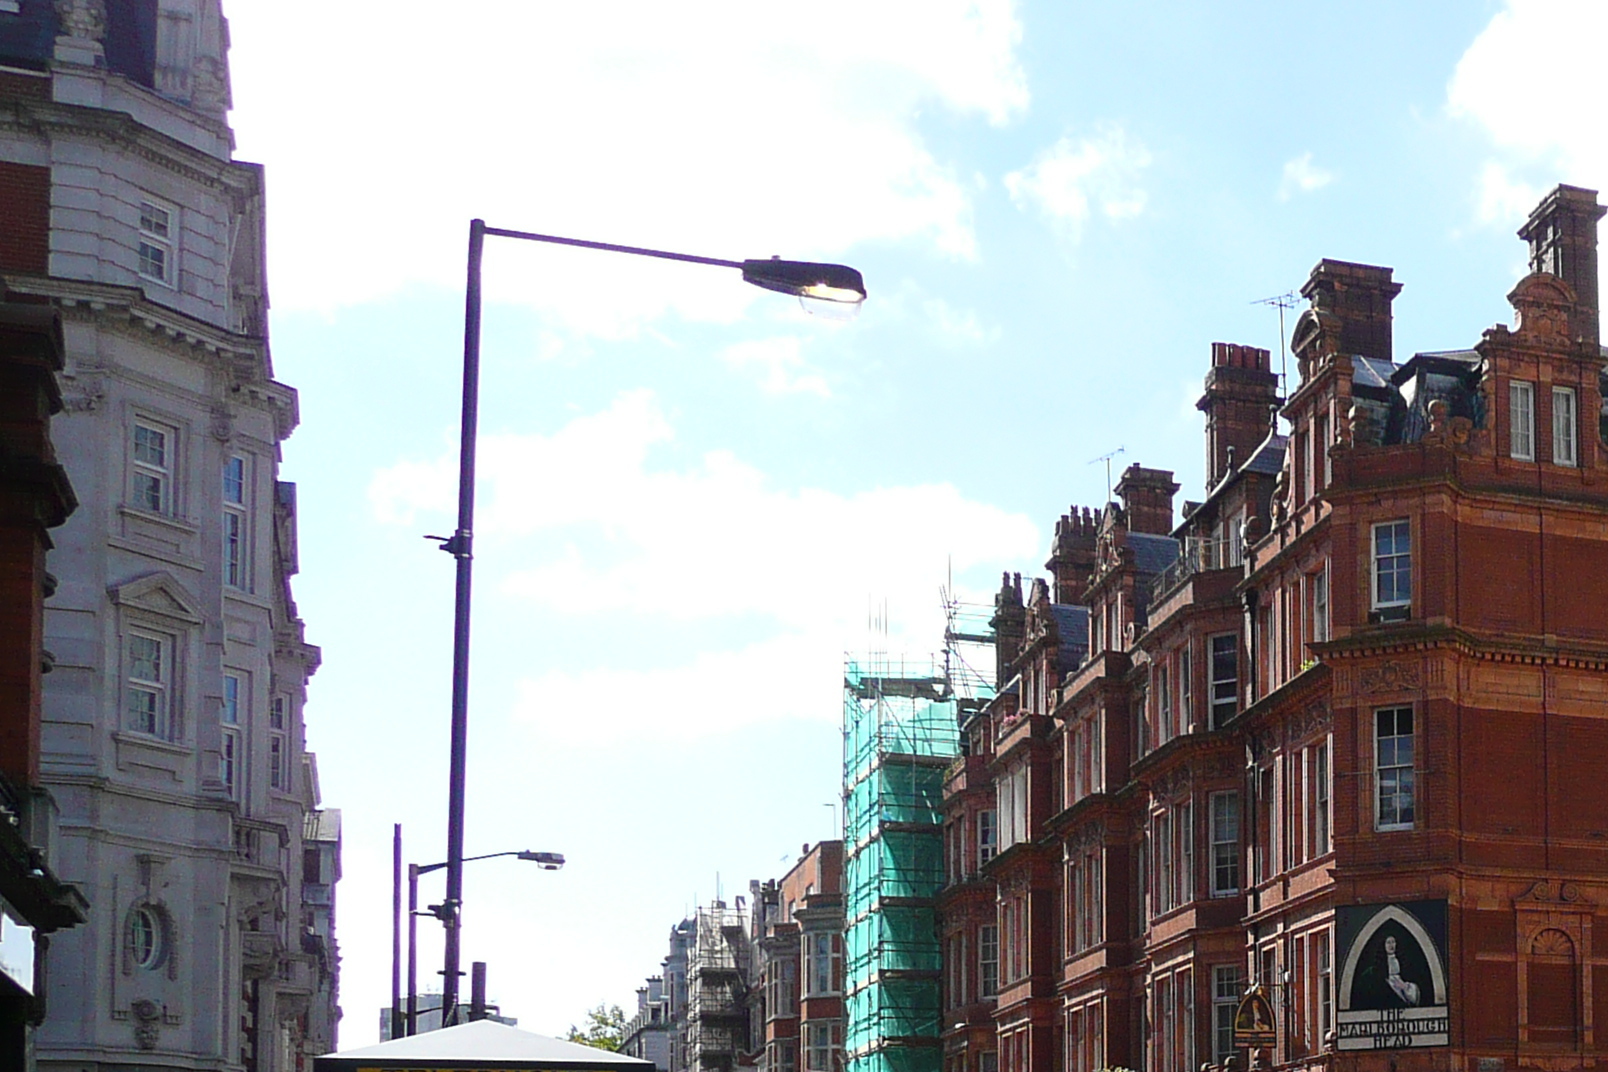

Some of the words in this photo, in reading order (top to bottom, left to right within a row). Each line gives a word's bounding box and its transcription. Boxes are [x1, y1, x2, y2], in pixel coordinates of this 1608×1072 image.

[1377, 1008, 1405, 1020] THE
[1339, 1020, 1447, 1037] MARLBOROUGH
[1374, 1035, 1412, 1048] HEAD
